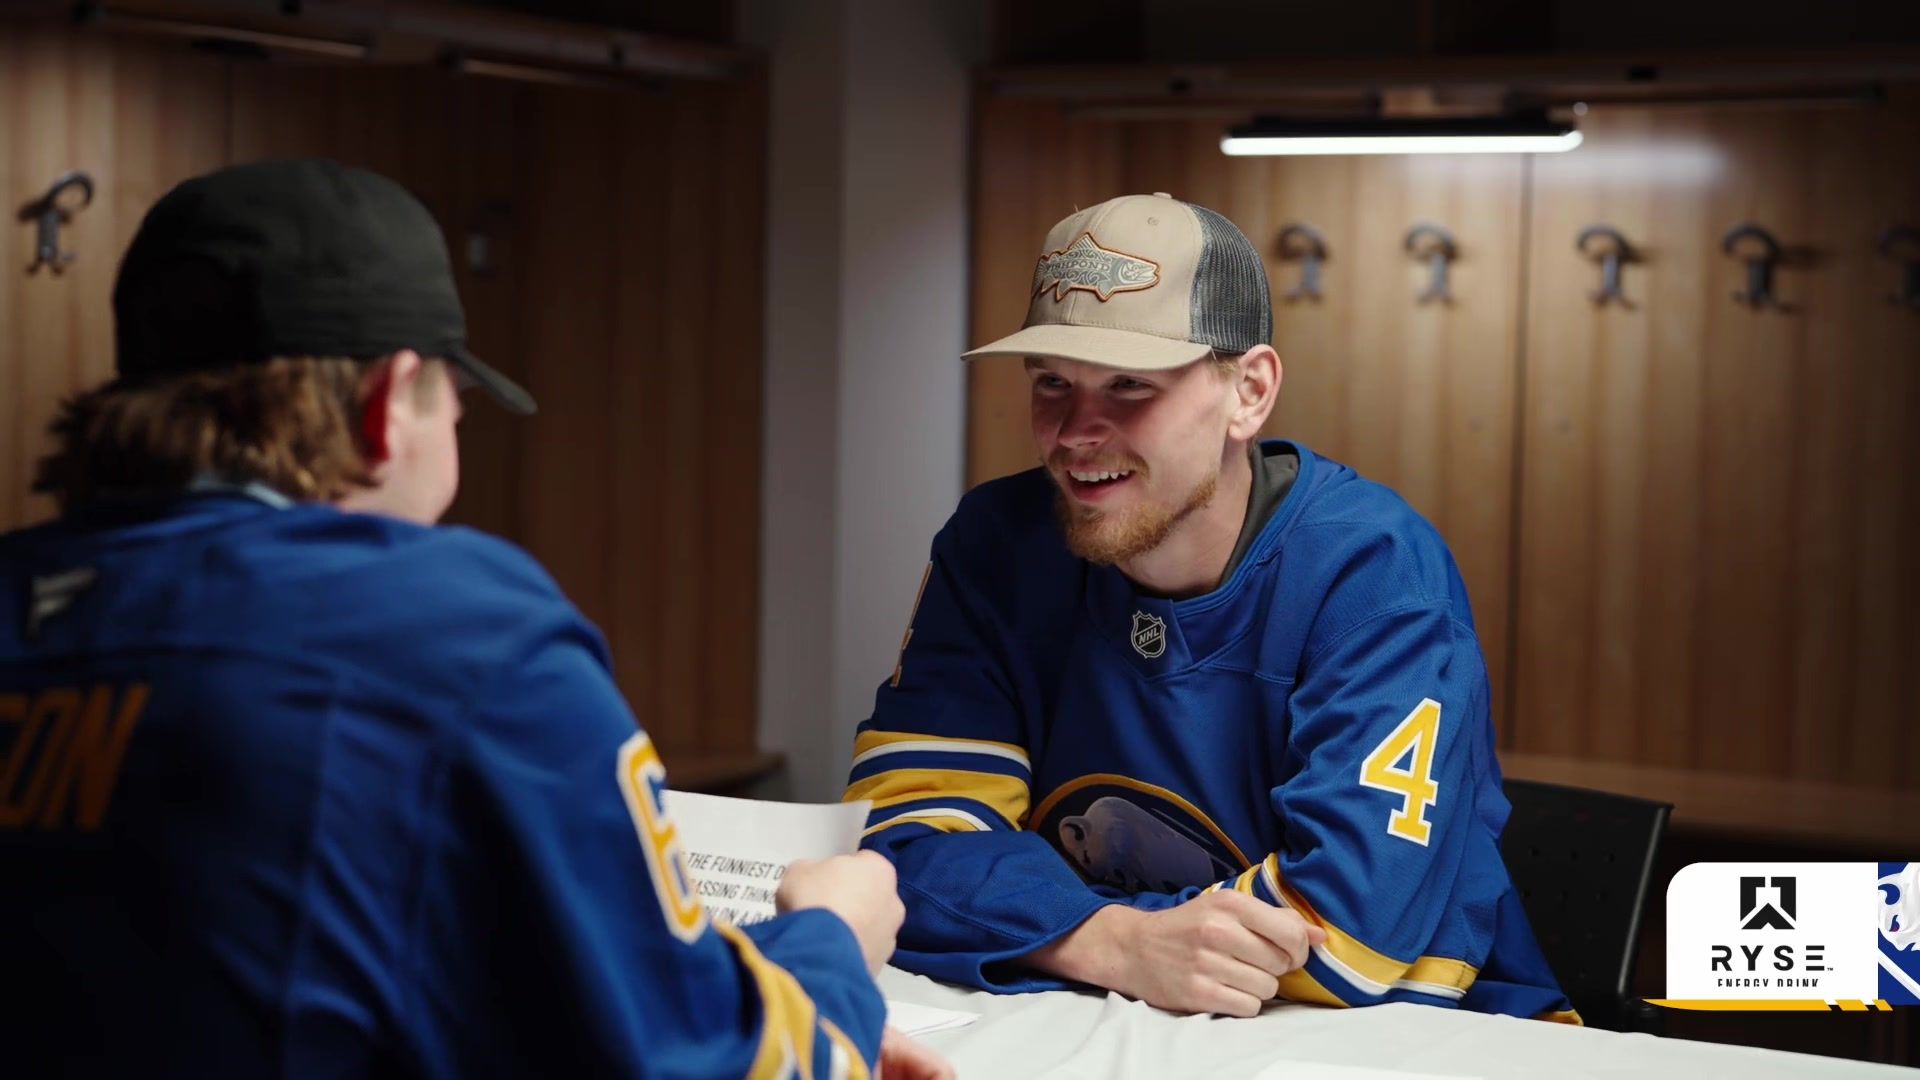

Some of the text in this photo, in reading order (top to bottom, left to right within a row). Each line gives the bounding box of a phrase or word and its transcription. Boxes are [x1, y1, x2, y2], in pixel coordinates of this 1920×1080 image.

[1138, 627, 1160, 645] NHL
[0, 681, 151, 831] ON
[1359, 697, 1441, 847] 4
[687, 852, 713, 870] THE
[711, 855, 775, 879] FUNNIEST
